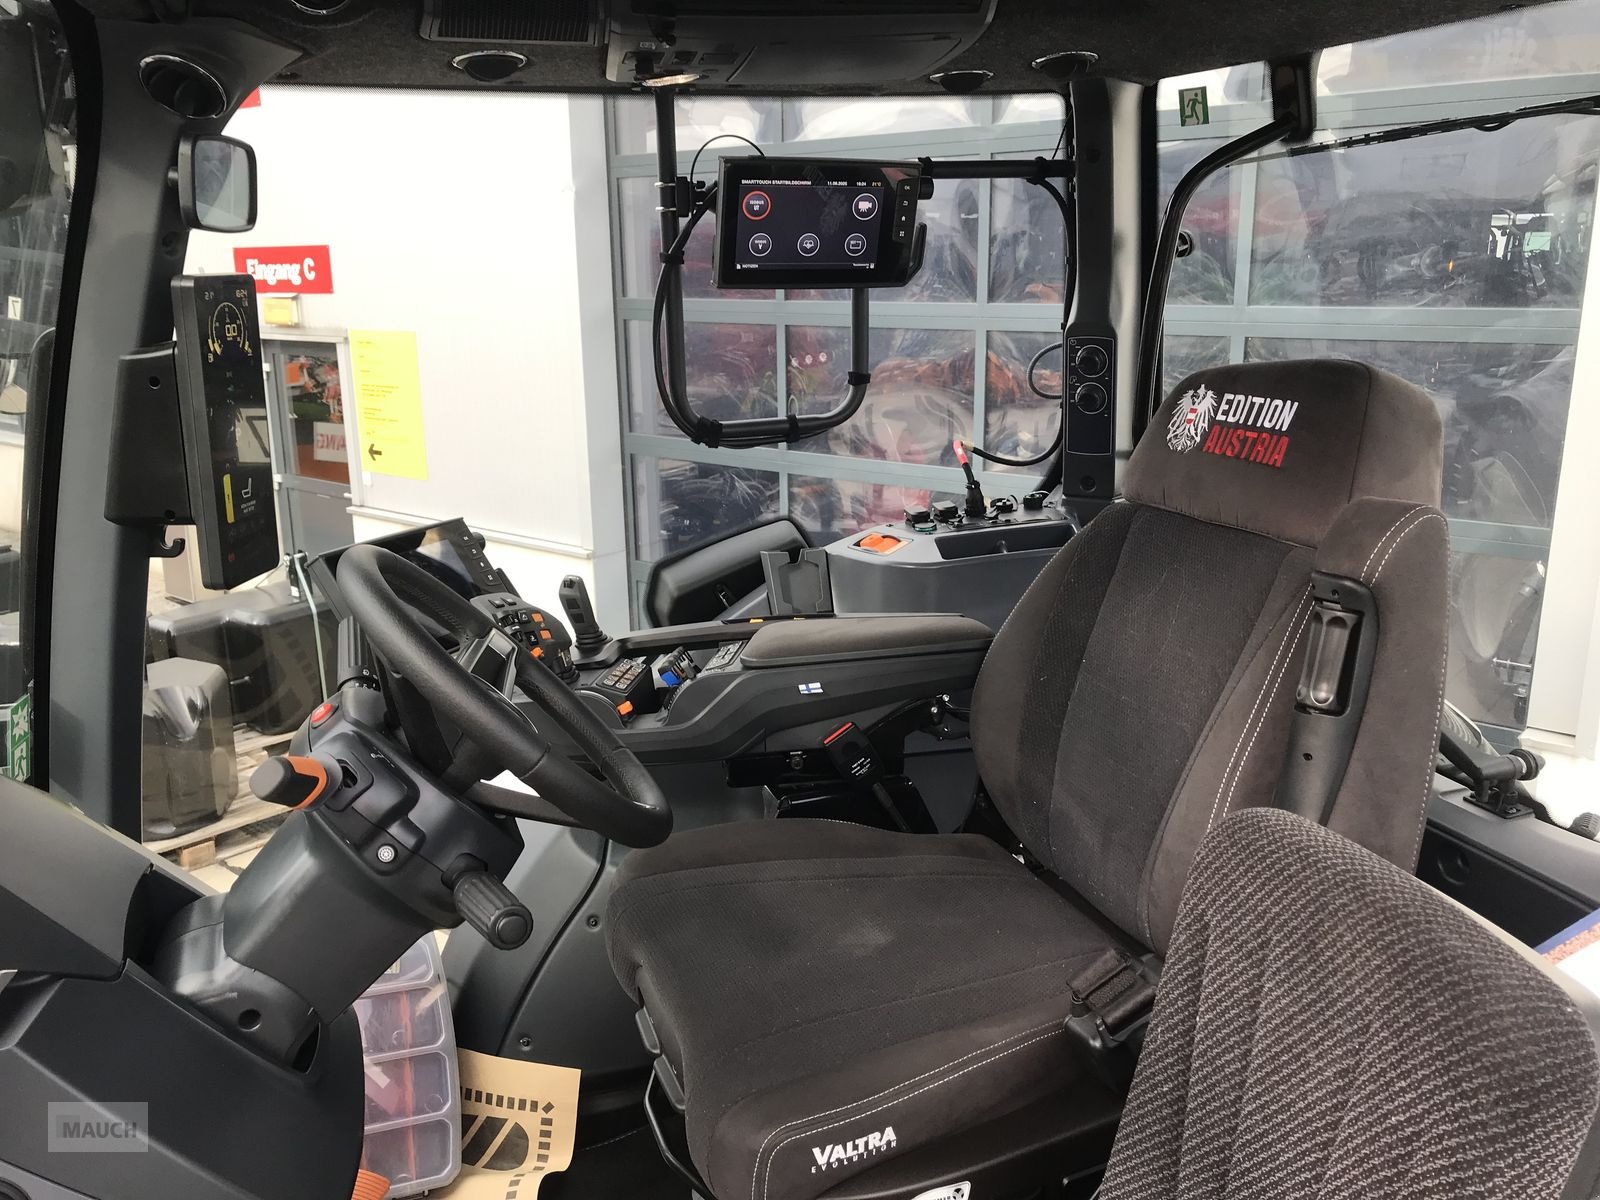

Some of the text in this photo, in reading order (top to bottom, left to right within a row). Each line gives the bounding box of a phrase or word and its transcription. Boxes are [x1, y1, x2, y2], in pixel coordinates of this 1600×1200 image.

[246, 257, 316, 286] Eingang C
[1215, 393, 1299, 432] EDITION
[1202, 424, 1290, 468] AUSTRIA
[811, 1140, 898, 1174] EVOLUTION
[812, 1126, 897, 1166] VALTRA
